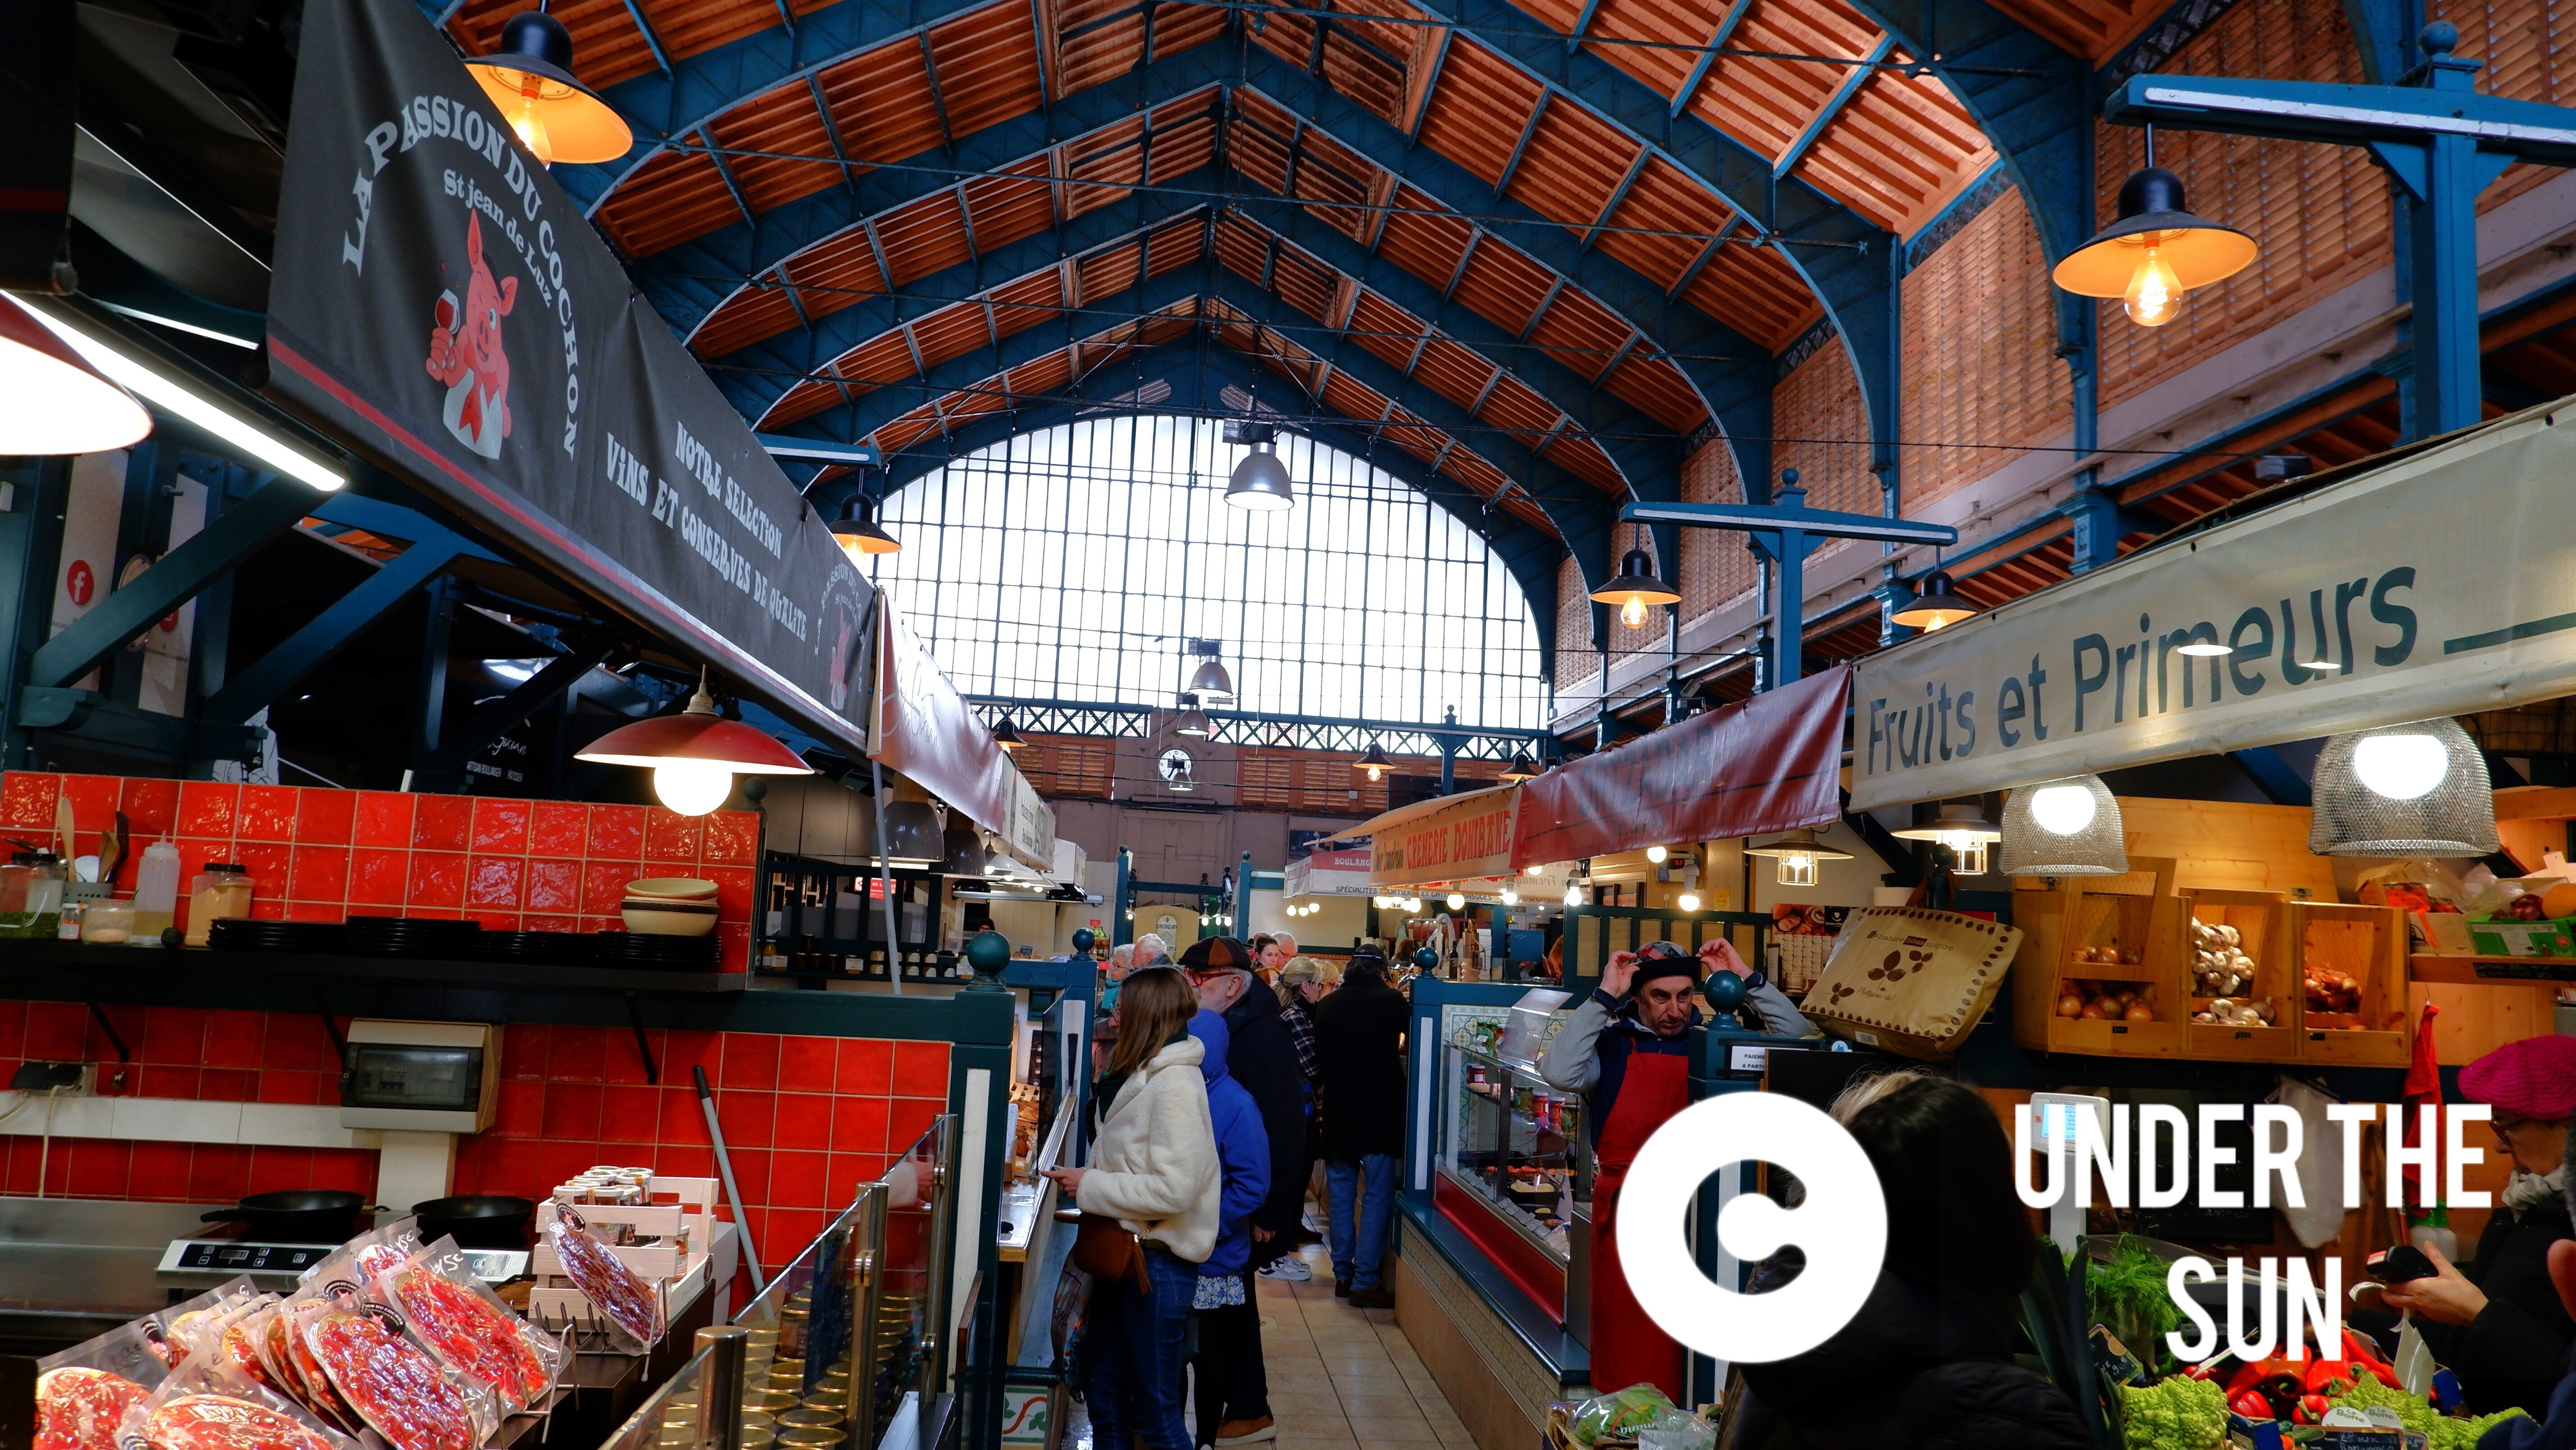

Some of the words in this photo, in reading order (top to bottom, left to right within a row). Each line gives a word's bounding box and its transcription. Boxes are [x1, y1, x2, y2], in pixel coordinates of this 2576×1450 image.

[444, 168, 464, 198] St
[465, 178, 504, 230] jean
[506, 218, 524, 252] de
[524, 250, 553, 309] Luz
[343, 168, 374, 277] LA
[364, 95, 506, 175] PASSION
[504, 154, 542, 221] DU
[539, 220, 579, 461] COCHON
[676, 421, 722, 501] NOTRE
[652, 479, 679, 530] ET
[681, 505, 751, 594] CONSERVES
[754, 570, 768, 609] DE
[821, 563, 848, 614] PASSION
[848, 570, 857, 595] DU
[1869, 681, 1976, 776] Fruits
[1998, 653, 2048, 748] et
[2073, 566, 2417, 732] Primeurs
[1334, 857, 1370, 866] BOULANG
[1407, 826, 1448, 870] CREMERIE
[1453, 809, 1511, 862] DONIBANE
[1925, 942, 1954, 951] inspire
[2336, 1409, 2365, 1423] Botte
[2368, 1409, 2394, 1419] Botte
